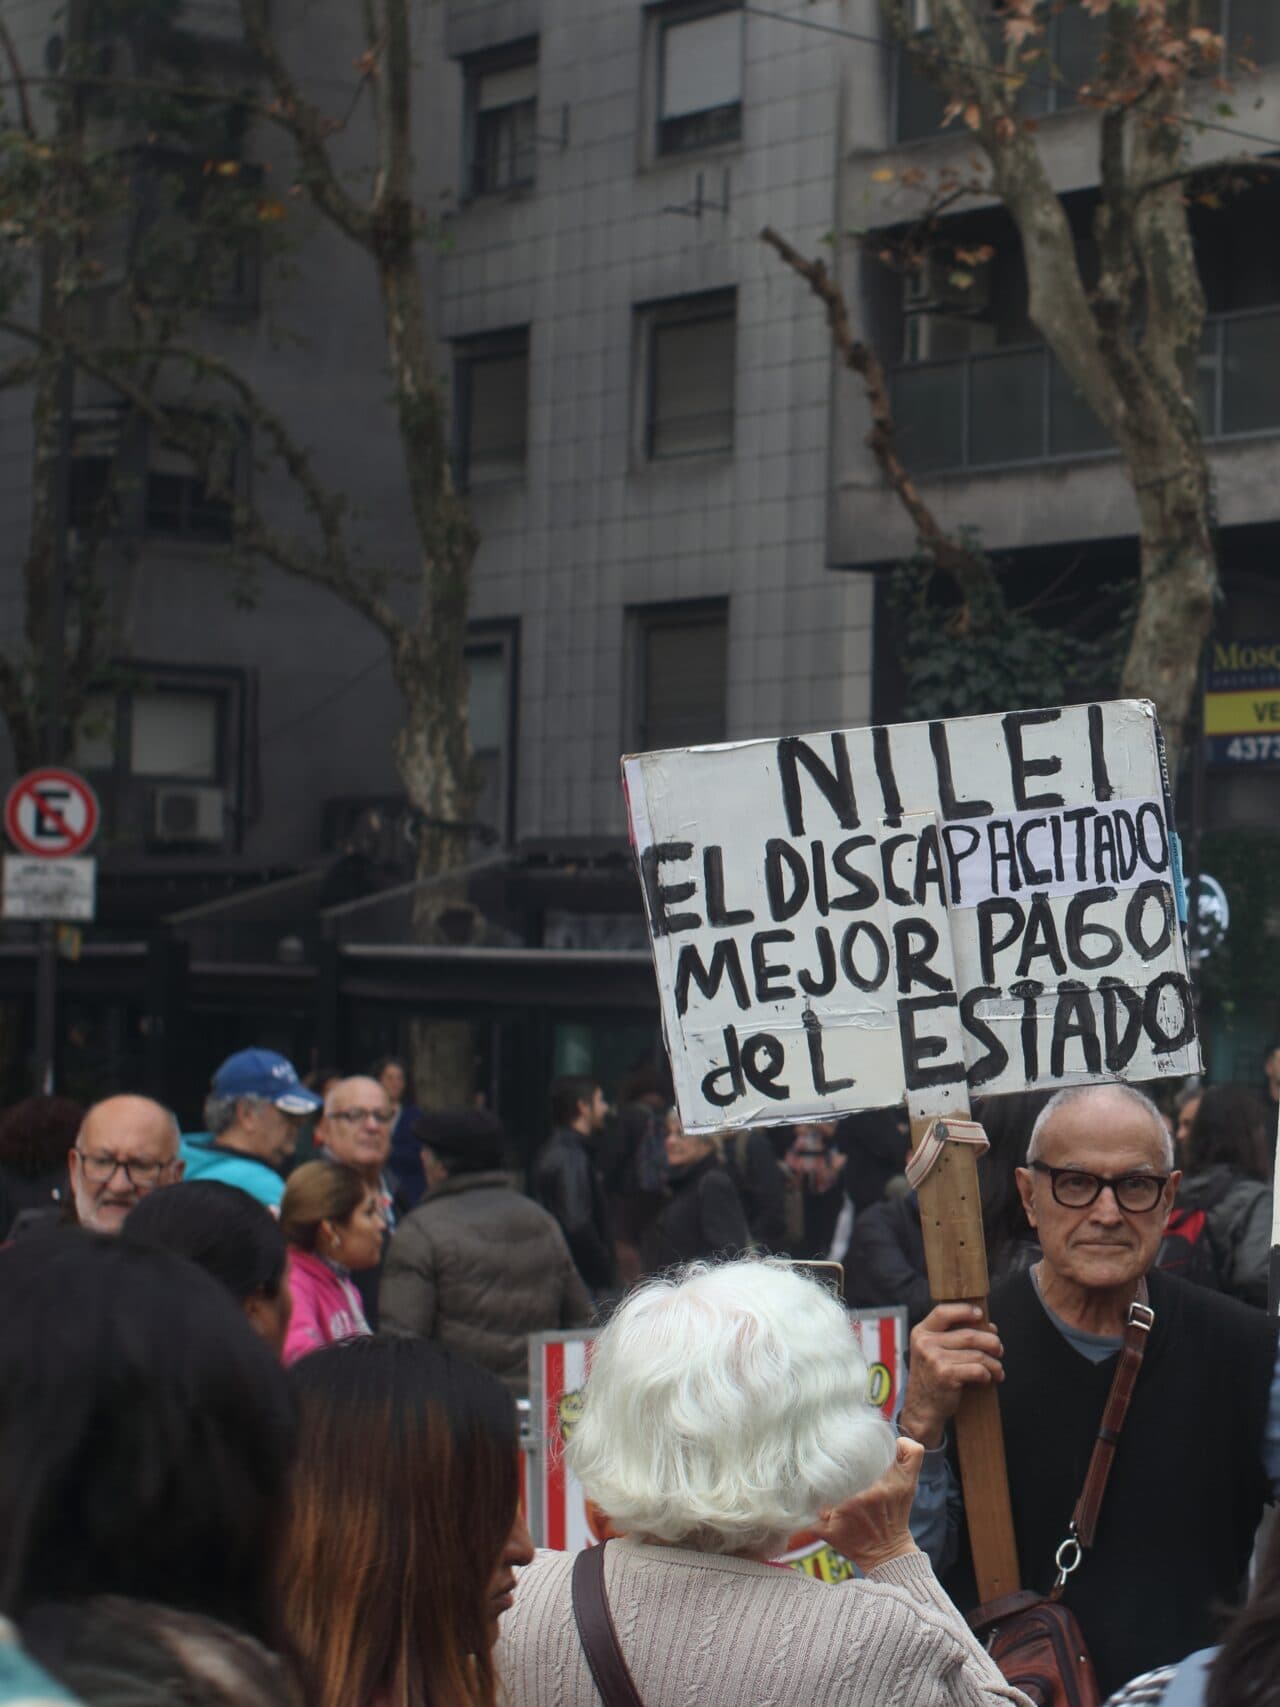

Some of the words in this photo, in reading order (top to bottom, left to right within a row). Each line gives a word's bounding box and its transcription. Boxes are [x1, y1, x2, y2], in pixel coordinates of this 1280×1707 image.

[643, 842, 755, 938] EL
[765, 802, 1169, 922] DISCAPACITADO
[675, 917, 953, 1017] MEJOR
[978, 880, 1172, 984] PAGO
[897, 972, 1195, 1090] ESTADO
